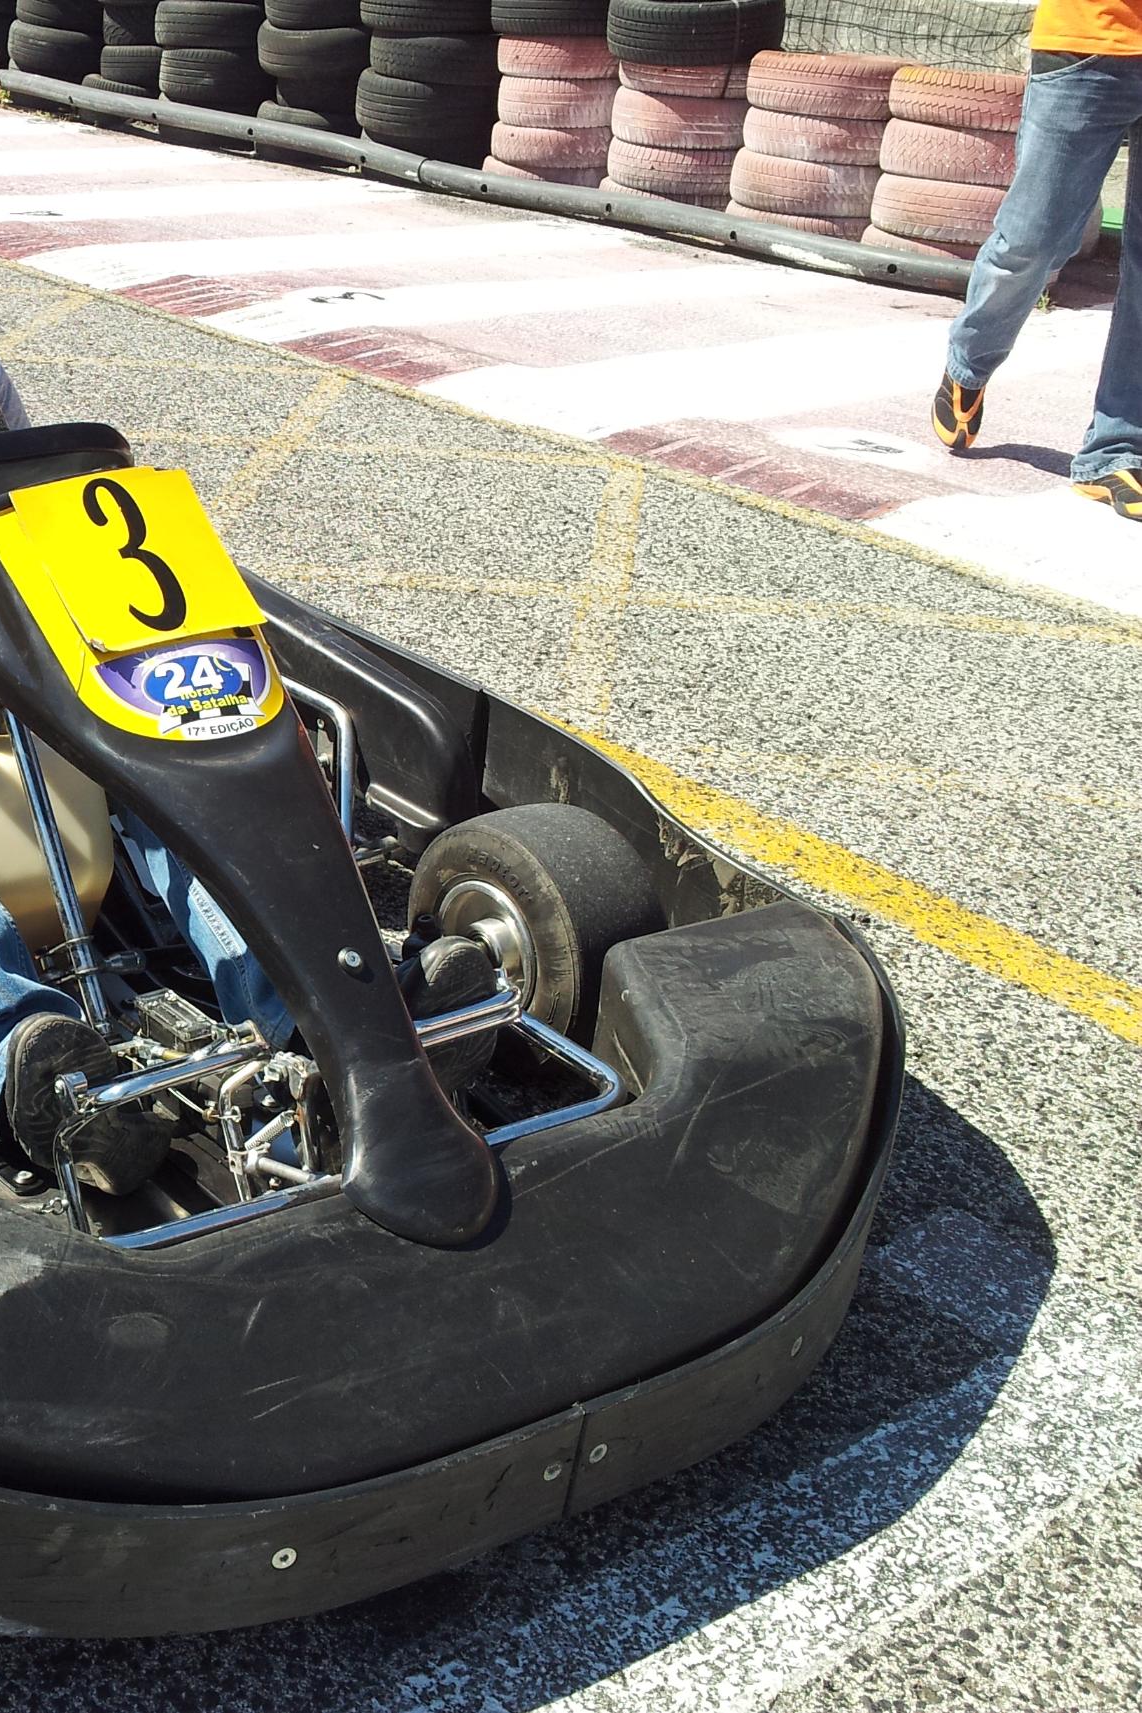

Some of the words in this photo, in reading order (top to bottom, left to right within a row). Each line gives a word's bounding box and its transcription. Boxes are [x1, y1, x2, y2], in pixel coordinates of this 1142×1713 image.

[82, 477, 187, 632] 3
[154, 655, 224, 700] 24
[166, 704, 188, 718] da
[190, 693, 249, 713] Batalha
[210, 717, 254, 736] EDIÇÃO
